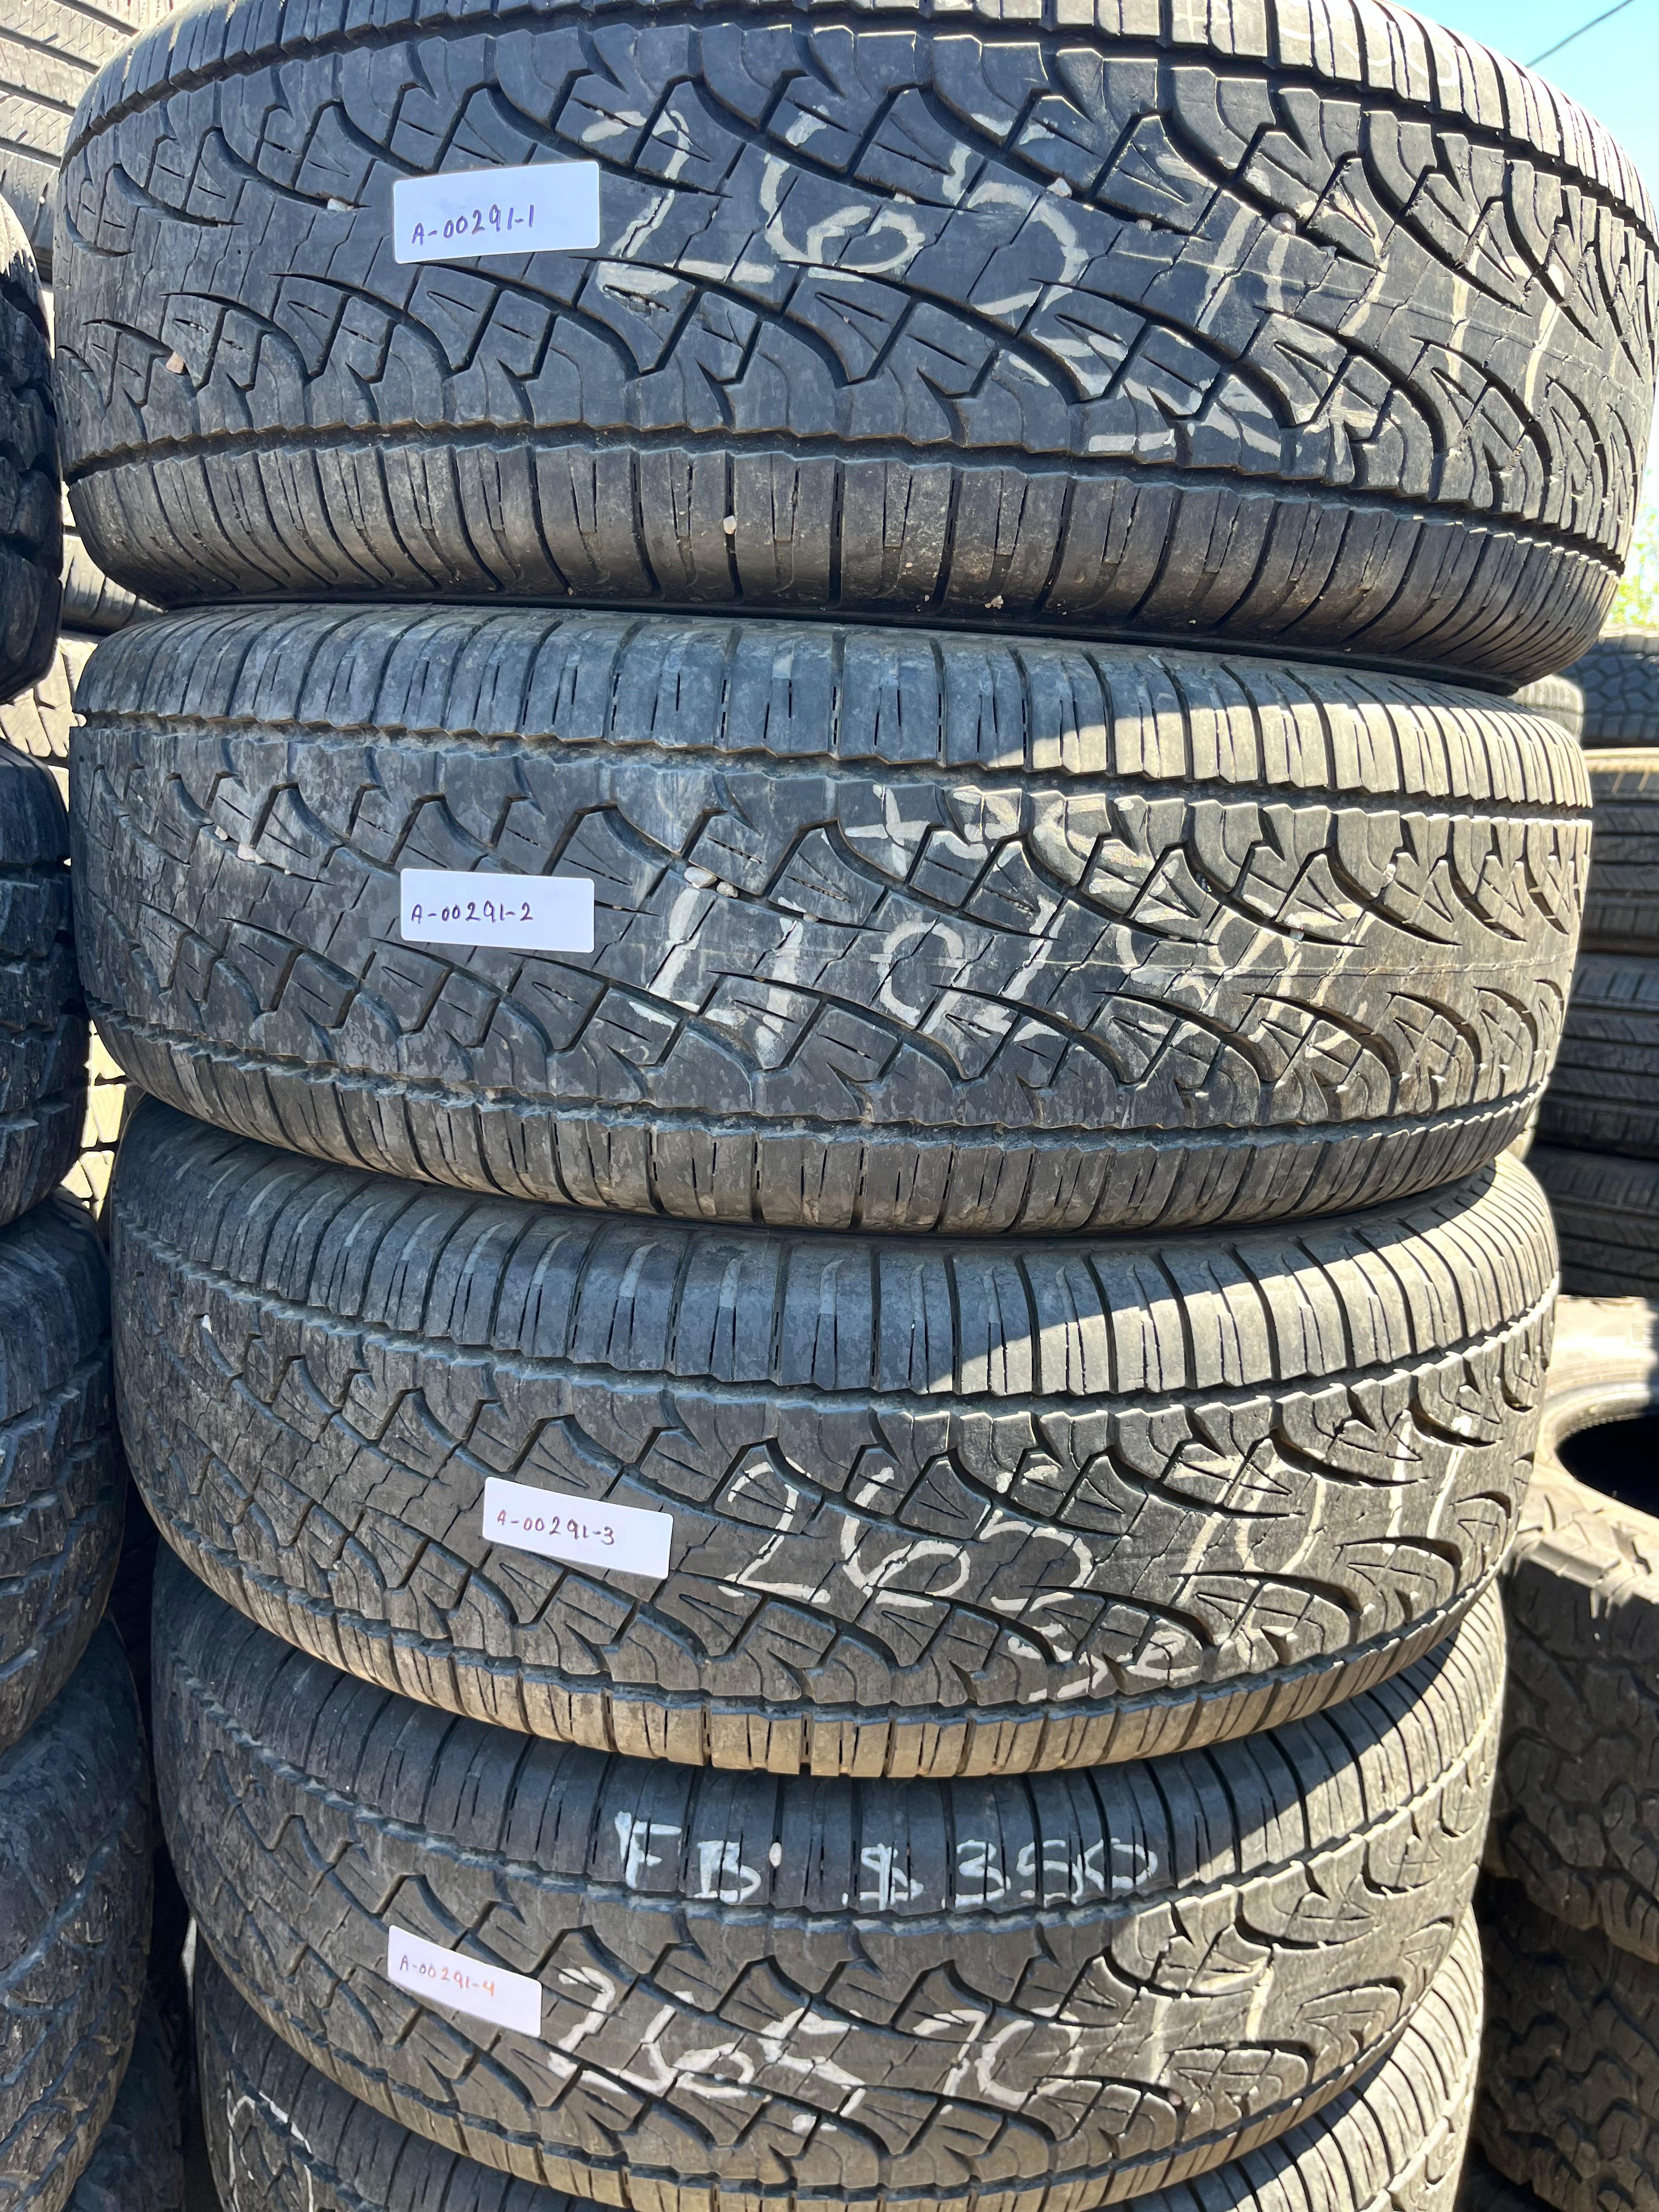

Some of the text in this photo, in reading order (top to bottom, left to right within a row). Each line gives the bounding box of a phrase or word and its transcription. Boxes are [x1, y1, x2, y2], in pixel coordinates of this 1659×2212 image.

[411, 204, 534, 245] A-00291-1
[411, 900, 534, 924] A-00291-2
[497, 1509, 615, 1545] A-00291-3
[720, 1458, 1093, 1611] 265
[400, 1954, 494, 1997] A-00291-4
[549, 1966, 866, 2132] 265
